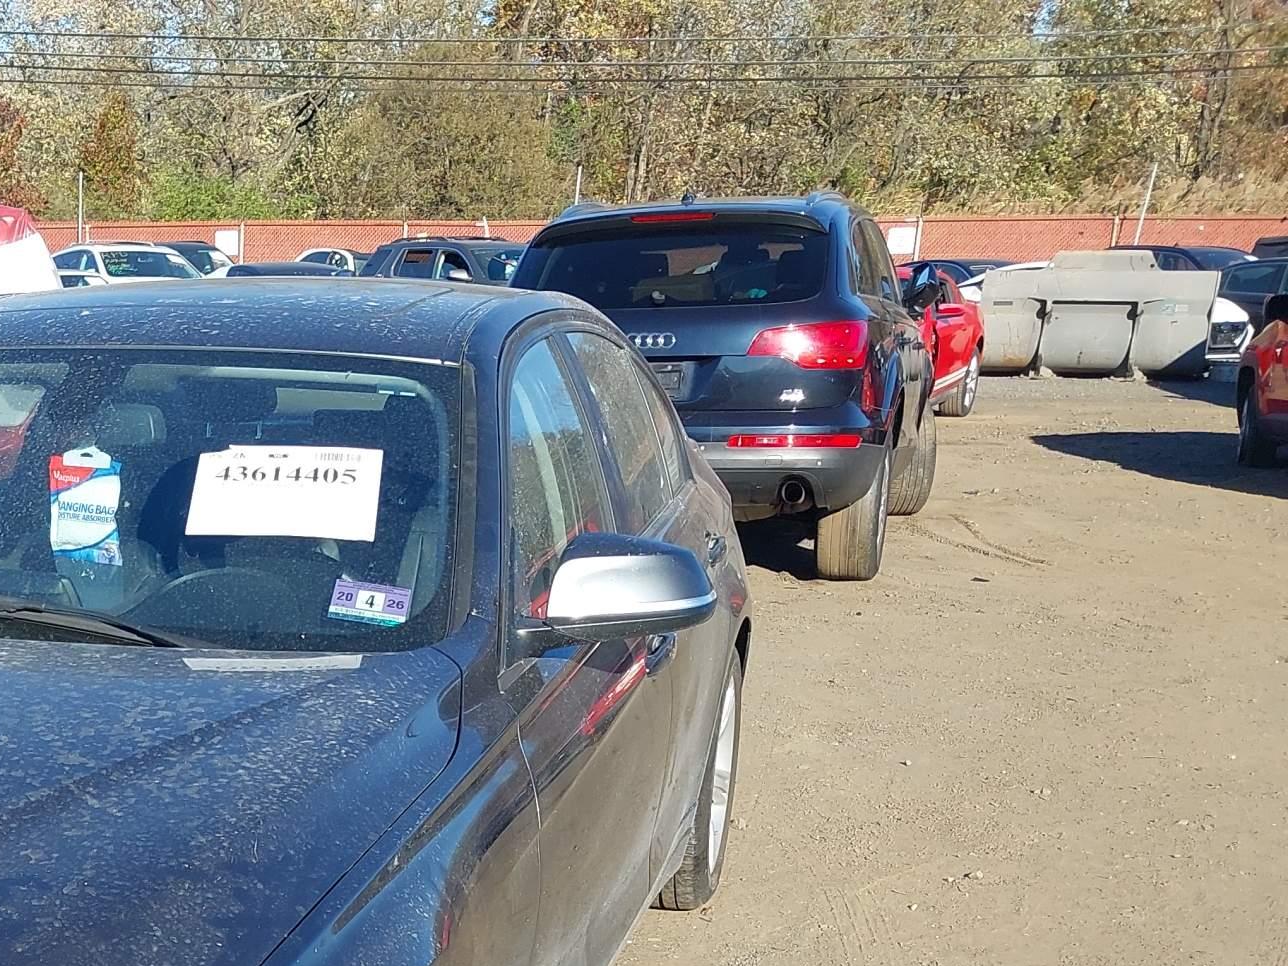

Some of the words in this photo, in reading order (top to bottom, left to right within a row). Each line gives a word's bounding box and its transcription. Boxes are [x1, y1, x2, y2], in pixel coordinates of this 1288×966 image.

[215, 465, 358, 484] 43614405
[95, 504, 115, 516] BAG
[336, 591, 354, 602] 20
[365, 594, 376, 609] 4
[386, 599, 404, 610] 26
